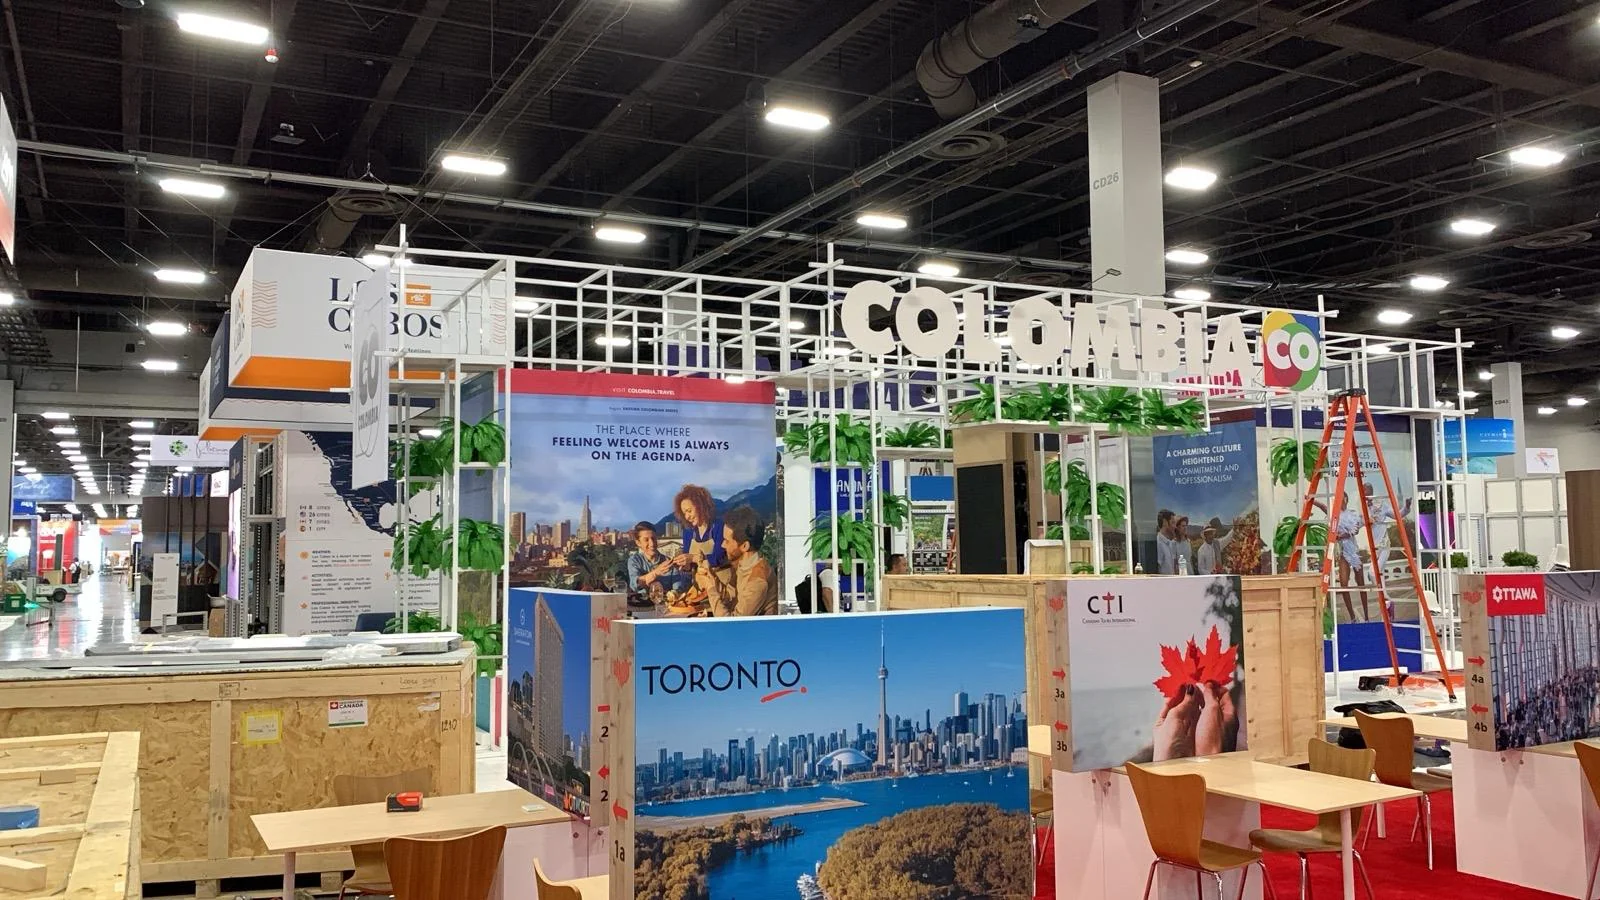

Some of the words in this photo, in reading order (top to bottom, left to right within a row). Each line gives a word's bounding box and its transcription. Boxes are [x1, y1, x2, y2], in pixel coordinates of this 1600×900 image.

[1093, 172, 1119, 190] CD26
[328, 306, 442, 339] CBOS
[841, 280, 1257, 377] COLOMBIA
[1266, 329, 1319, 371] CO
[596, 425, 615, 434] THE
[619, 426, 651, 435] PLACE
[655, 427, 690, 436] WHERE
[552, 437, 602, 447] FEELING
[607, 438, 665, 449] WELCOME
[670, 439, 680, 449] IS
[685, 440, 729, 450] ALWAYS
[591, 451, 611, 460] ON
[616, 452, 637, 461] THE
[641, 452, 695, 462] AGENDA.
[1166, 450, 1171, 458] A
[1173, 447, 1210, 457] CHARMING
[1212, 444, 1241, 454] CULTURE
[1182, 455, 1224, 466] HEIGHTENED
[1179, 466, 1222, 476] COMMITMENT
[1174, 475, 1233, 485] PROFESSIONALISM
[1492, 585, 1538, 603] OTTAWA
[641, 659, 801, 695] TORONTO
[1471, 674, 1485, 684] 4a
[1055, 688, 1065, 699] 3a
[1474, 722, 1488, 732] 4b
[1056, 740, 1067, 751] 3b
[614, 840, 625, 862] 1a
